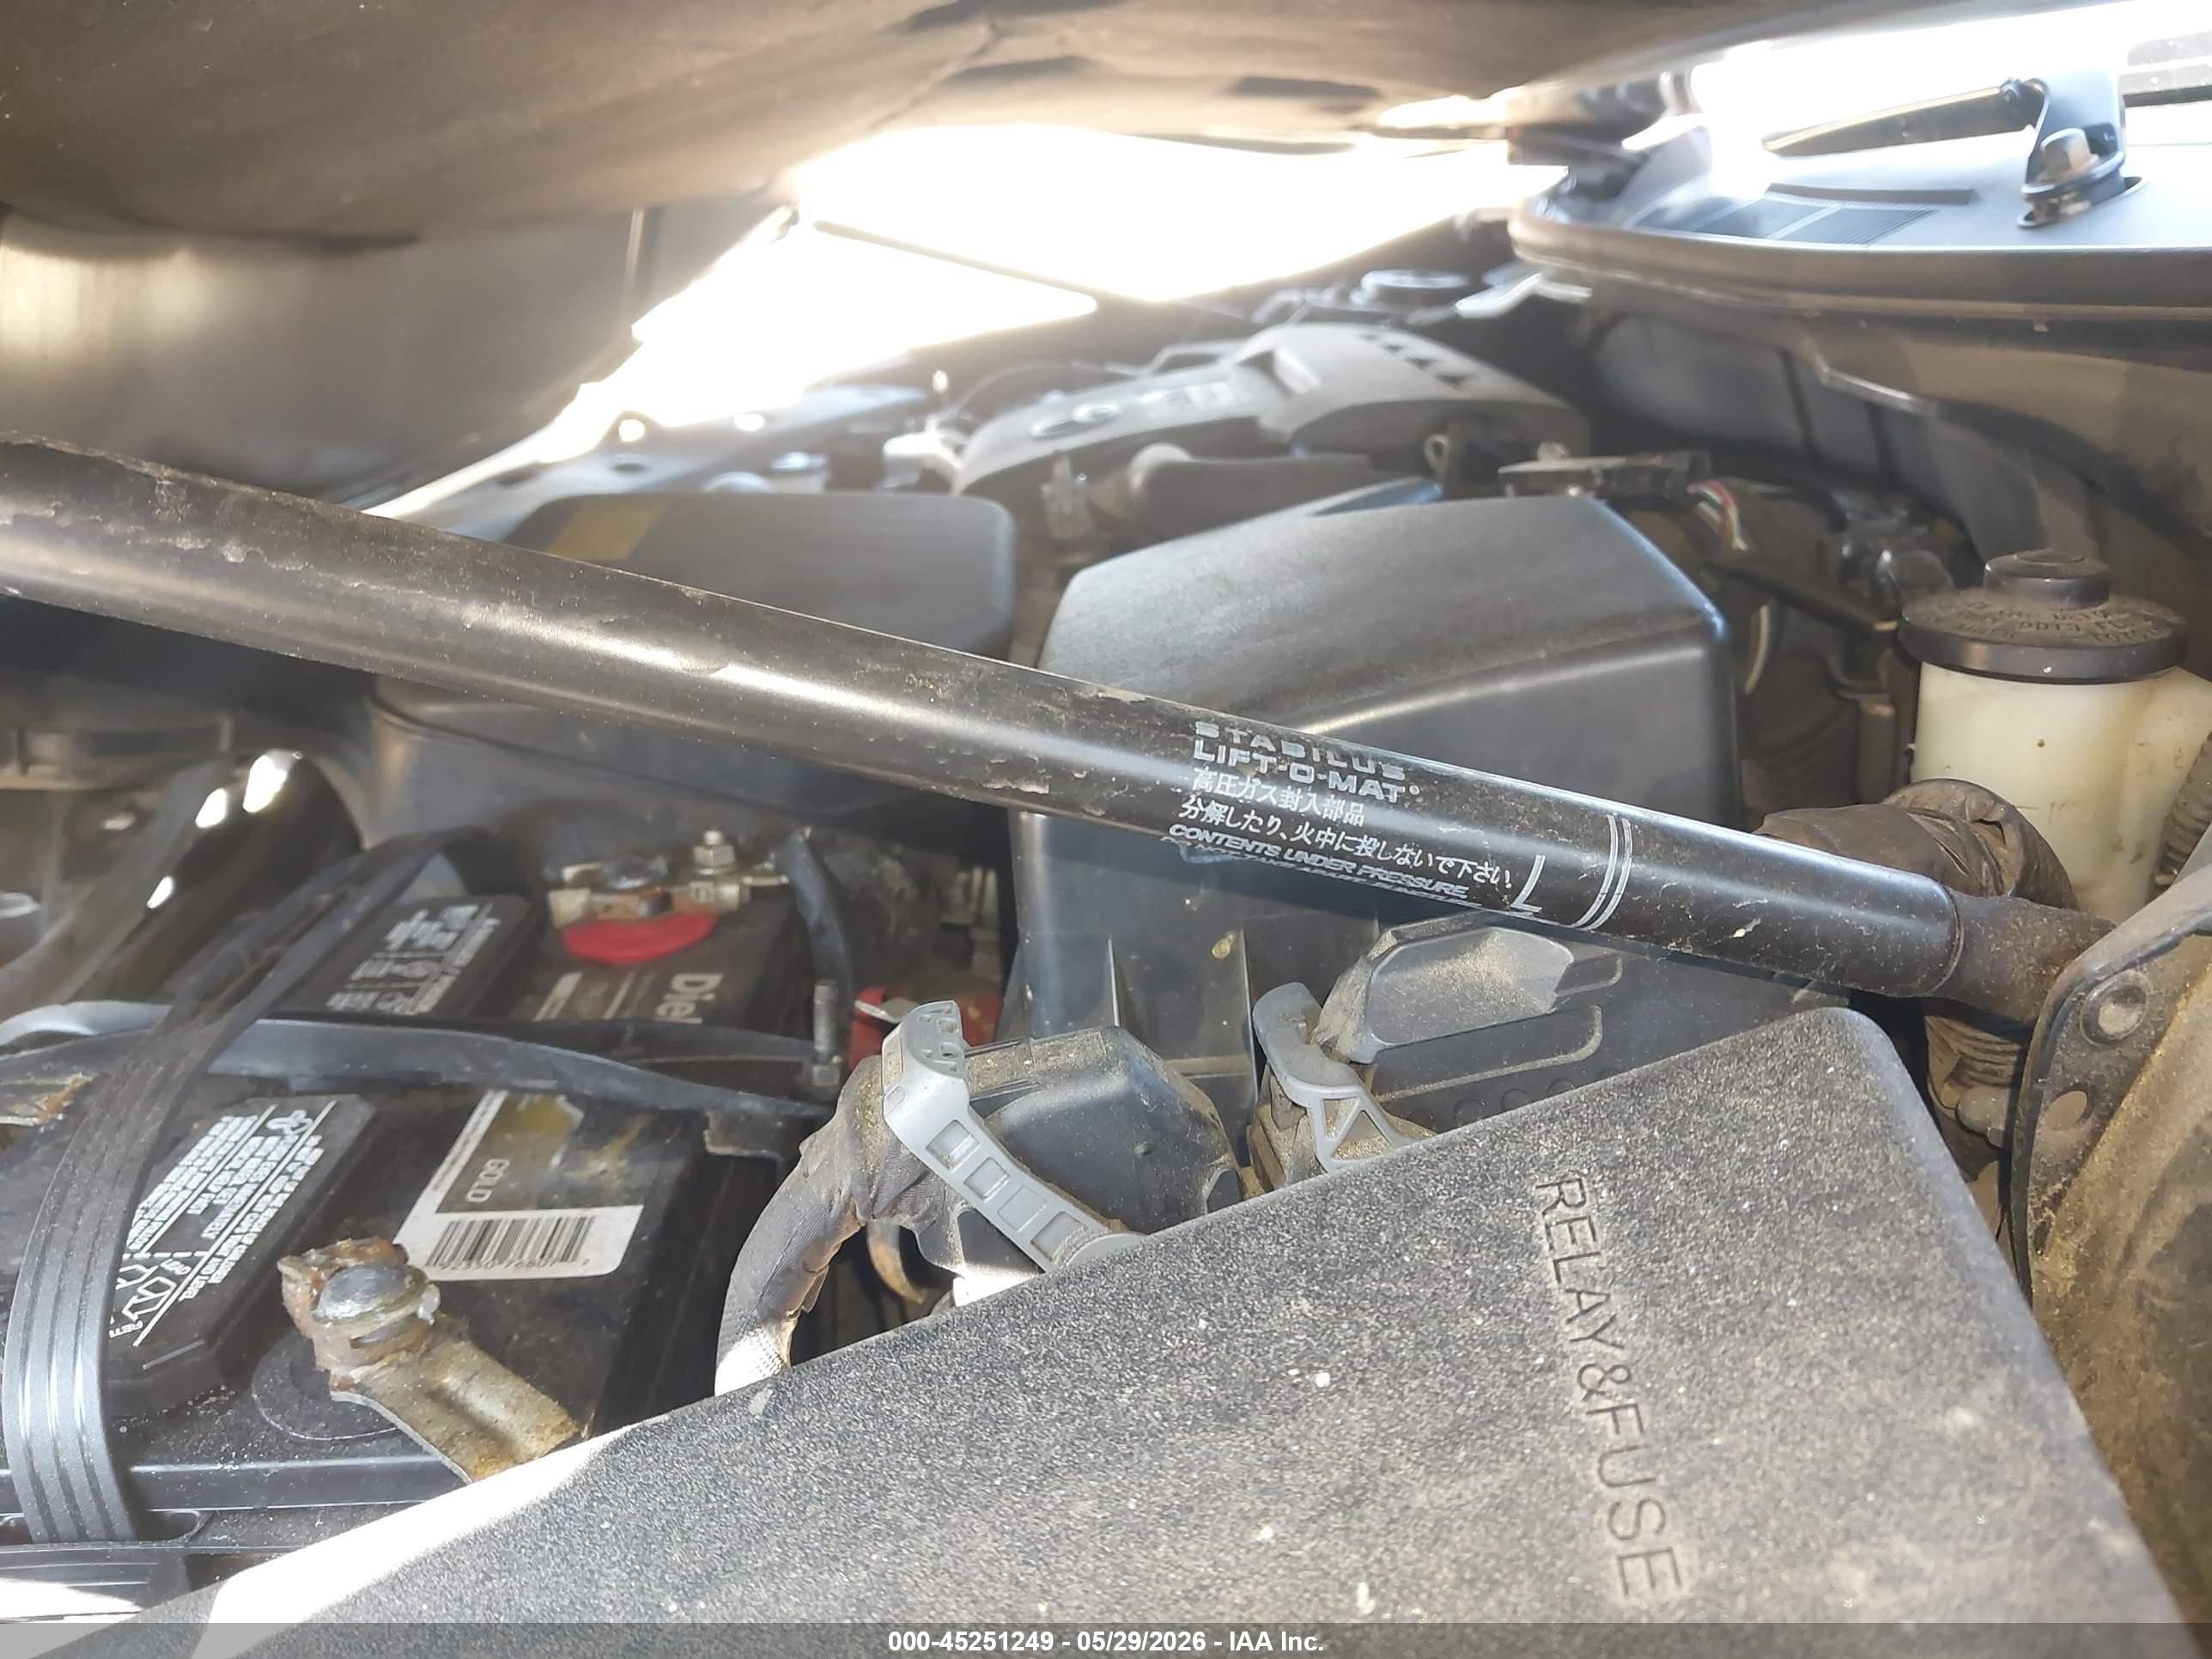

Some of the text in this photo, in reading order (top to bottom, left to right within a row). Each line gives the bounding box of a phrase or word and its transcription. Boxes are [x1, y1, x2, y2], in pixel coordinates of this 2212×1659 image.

[1194, 720, 1406, 781] STABILUS
[1192, 765, 1365, 827] 高圧ガス封入部品
[1169, 823, 1282, 858] CONTENTS
[1283, 848, 1357, 874] UNDER
[466, 1158, 510, 1203] GOLD
[1535, 1177, 1683, 1596] RELAY&FUSE
